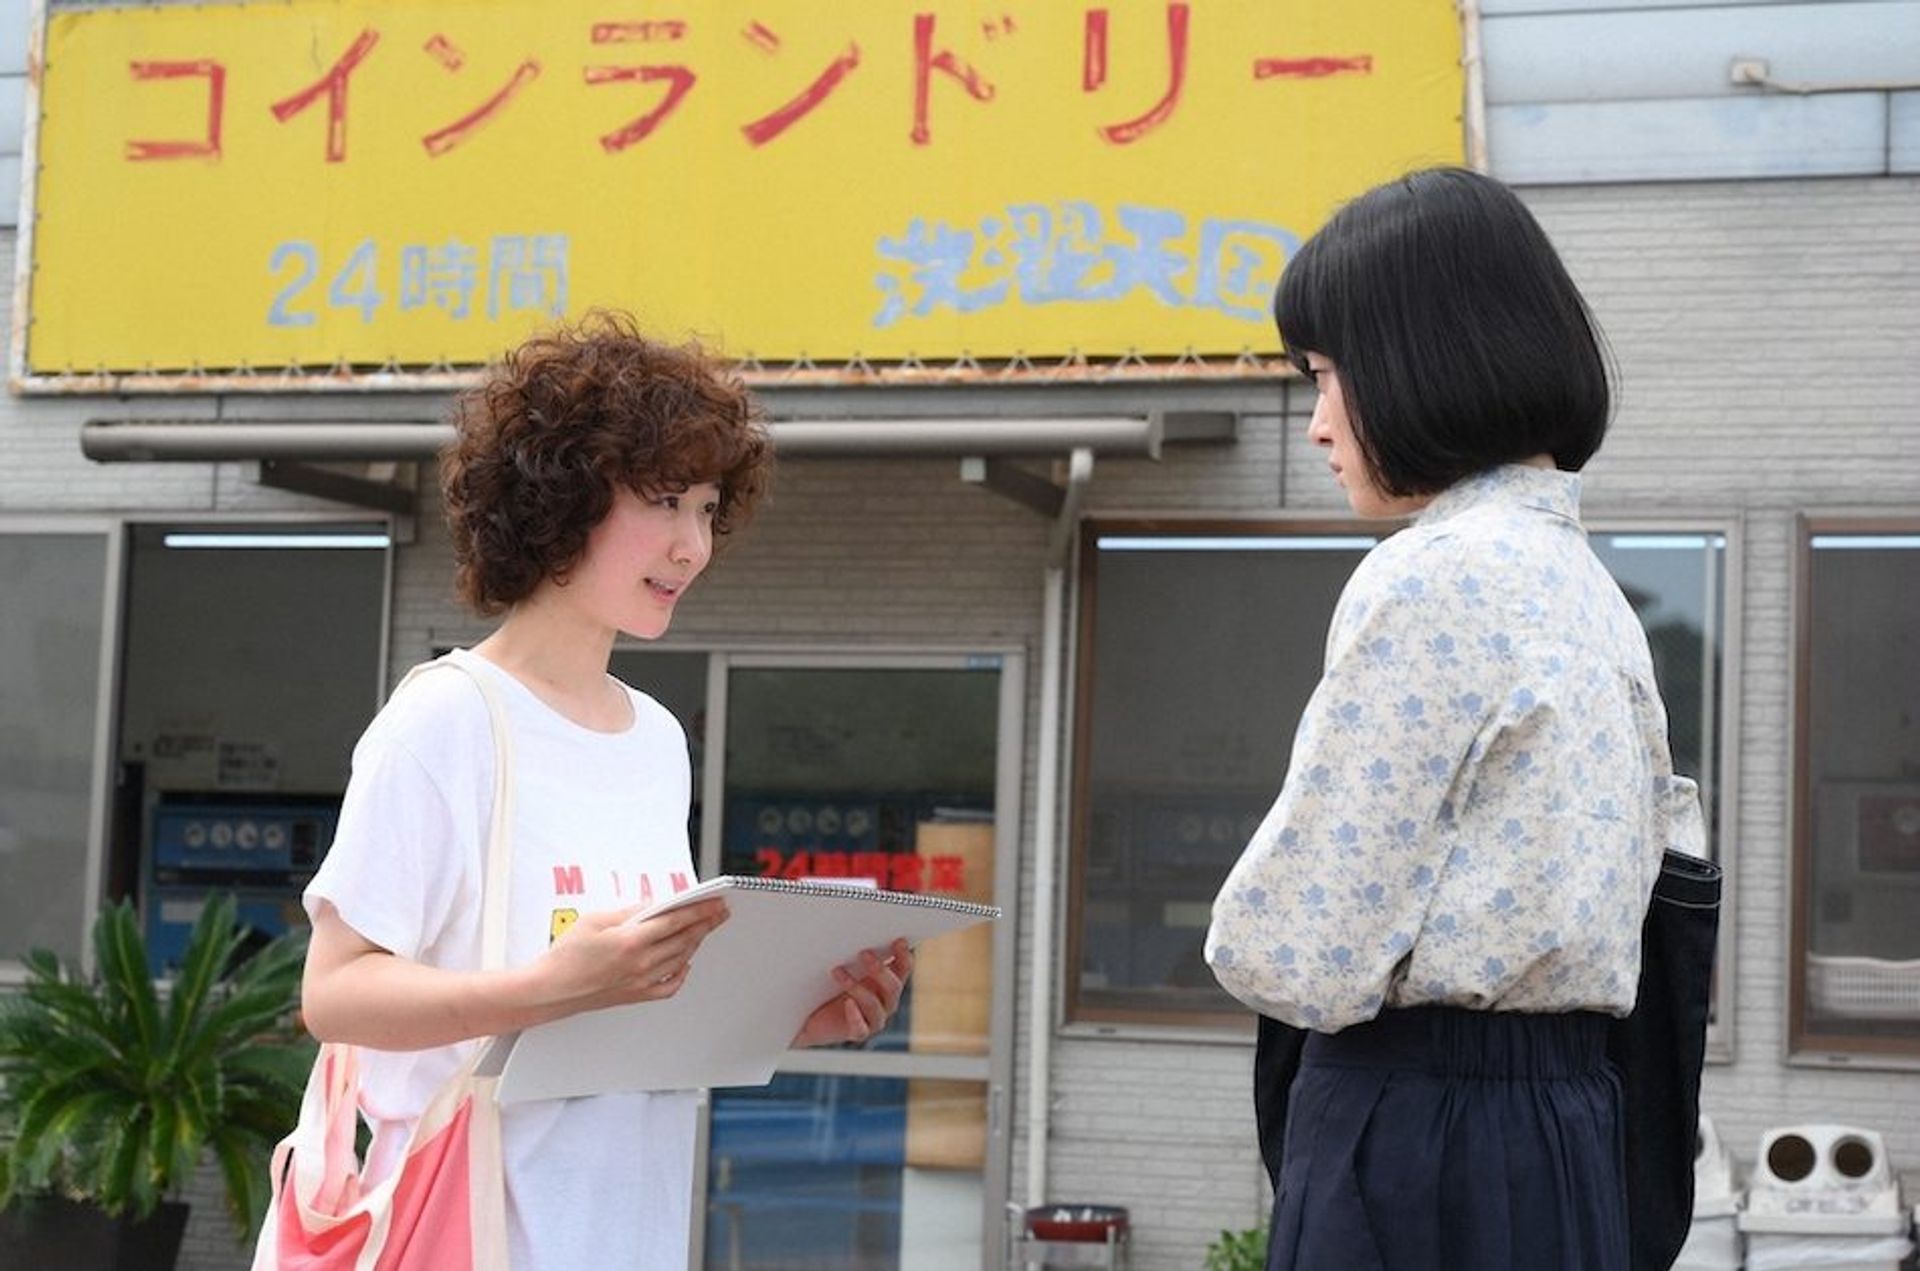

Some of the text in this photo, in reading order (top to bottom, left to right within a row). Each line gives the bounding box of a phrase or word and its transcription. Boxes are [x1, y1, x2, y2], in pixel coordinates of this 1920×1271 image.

[125, 2, 1373, 163] コインランドリー
[266, 233, 571, 328] 24時間
[873, 201, 1300, 328] 洗濯天国
